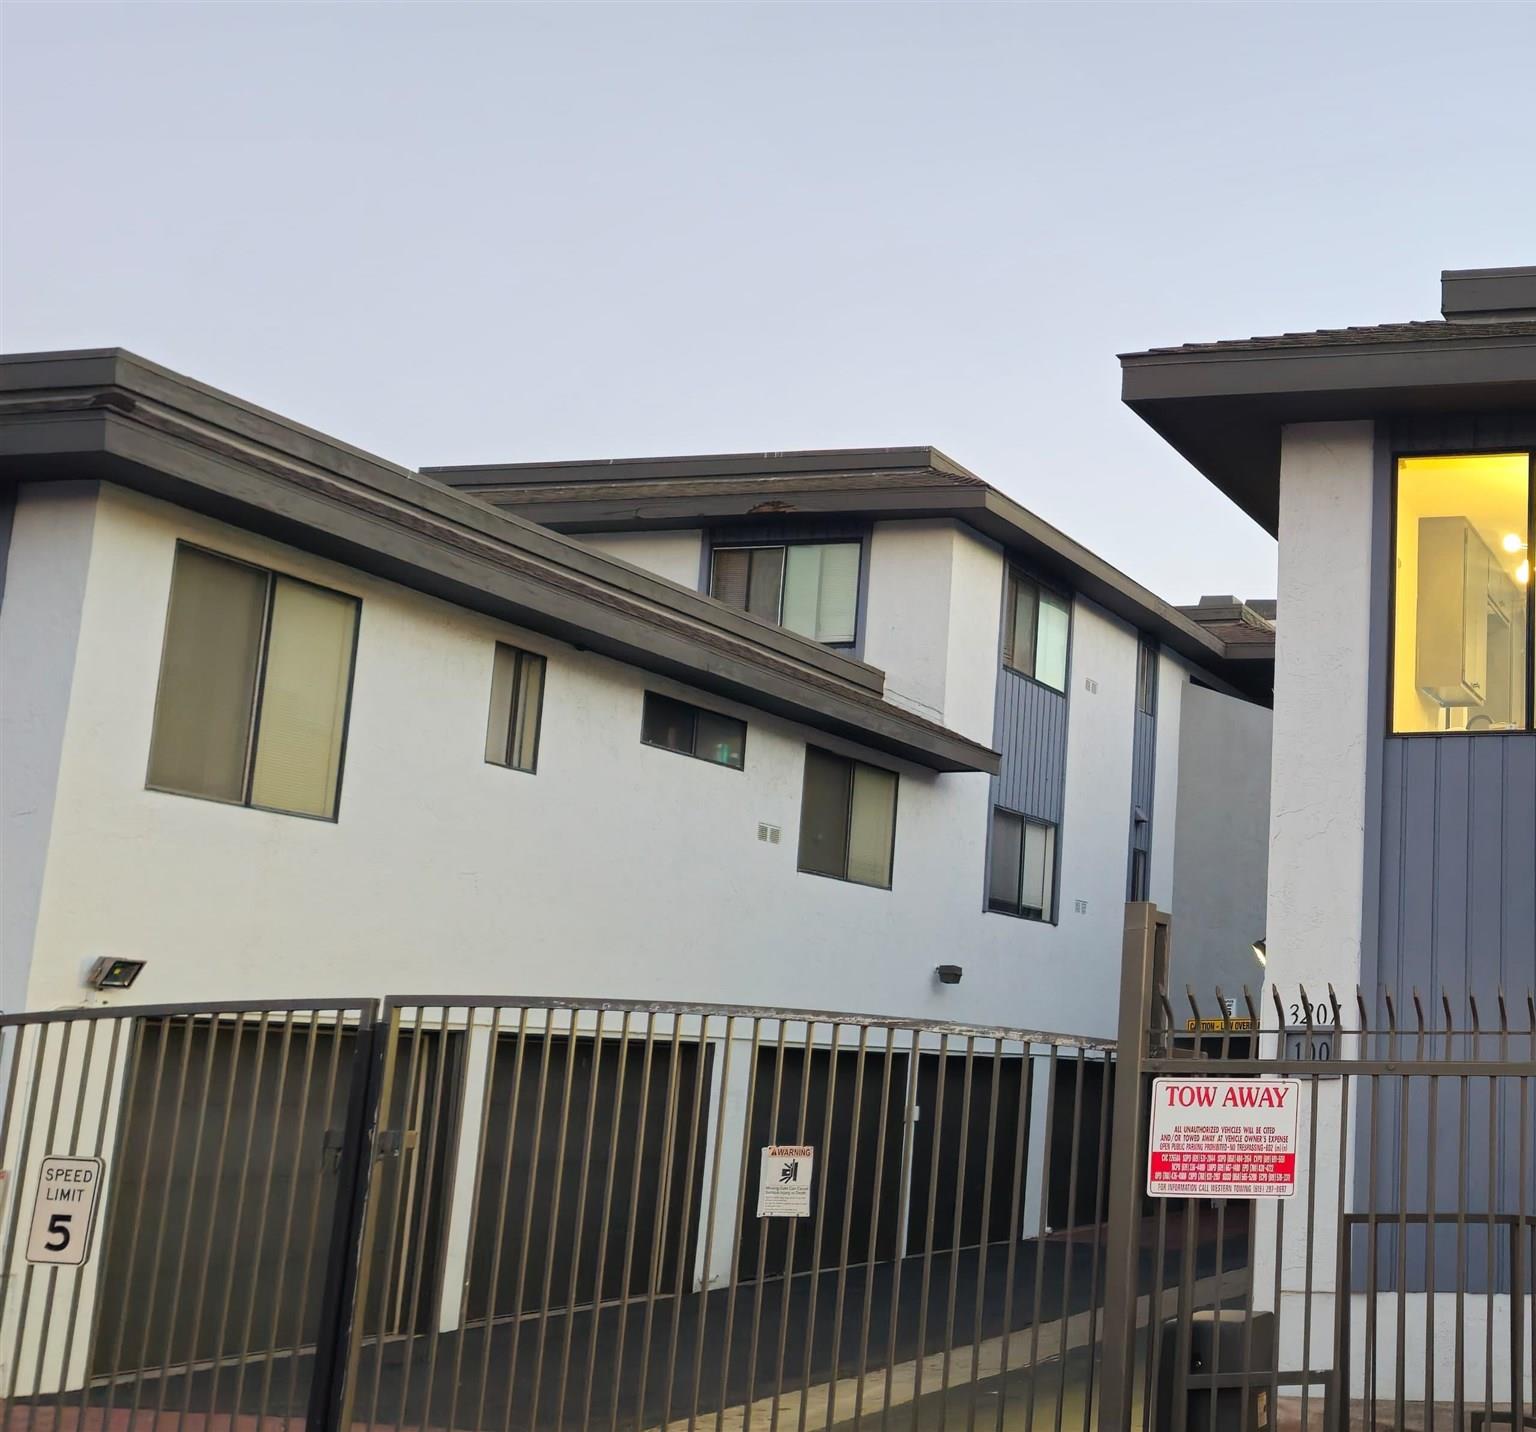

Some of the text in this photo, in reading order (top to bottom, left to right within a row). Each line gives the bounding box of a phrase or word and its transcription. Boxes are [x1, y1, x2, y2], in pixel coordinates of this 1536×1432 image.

[1189, 1022, 1215, 1030] CTION
[1220, 1022, 1233, 1030] LW
[1165, 1086, 1289, 1108] TOW AWAY
[1174, 1126, 1182, 1134] ALL
[1183, 1126, 1219, 1134] UNAUTHORIZED
[1221, 1126, 1241, 1134] VEHICLES
[1243, 1127, 1254, 1135] WILL
[1263, 1127, 1276, 1135] CITED
[1160, 1134, 1181, 1142] AND/OR
[1202, 1135, 1215, 1143] AWAY
[1225, 1135, 1242, 1143] VEHICLE
[1268, 1136, 1289, 1144] EXPENSE
[1171, 1143, 1185, 1151] PUBLIC
[1186, 1143, 1203, 1151] PARKING
[778, 1148, 811, 1157] WARNING
[45, 1168, 93, 1183] SPEED
[1158, 1183, 1167, 1191] FOR
[1168, 1184, 1197, 1192] INFORMATION
[1199, 1184, 1209, 1192] CALL
[1210, 1184, 1232, 1193] WESTERN
[1234, 1185, 1251, 1193] TOWING
[46, 1188, 85, 1202] LIMIT
[44, 1213, 72, 1252] 5
